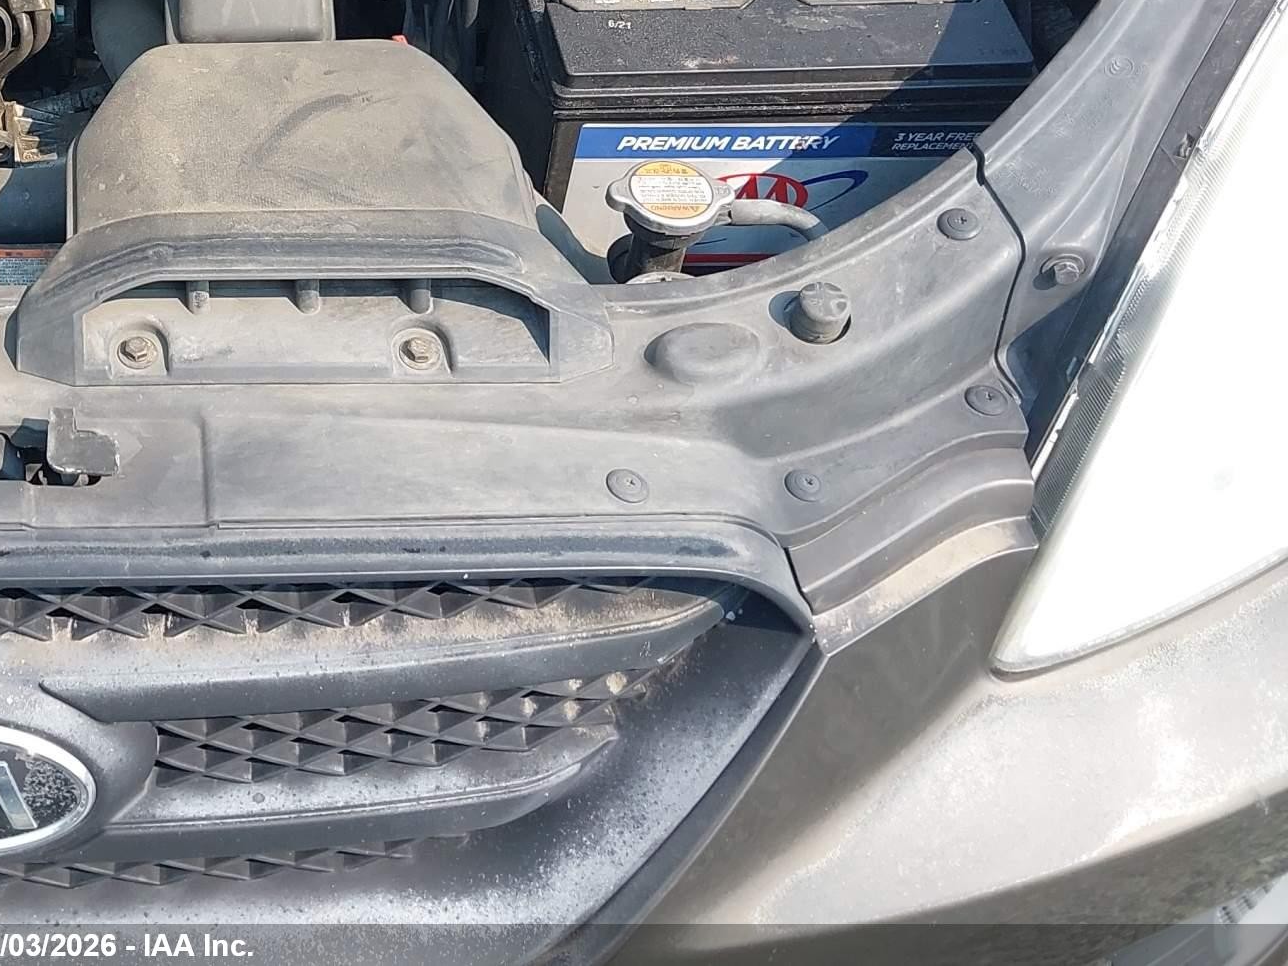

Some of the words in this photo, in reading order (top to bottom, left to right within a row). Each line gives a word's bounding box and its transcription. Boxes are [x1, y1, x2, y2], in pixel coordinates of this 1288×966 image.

[608, 19, 631, 29] 6/21
[894, 132, 907, 141] 3
[907, 132, 944, 141] YEAR
[617, 135, 730, 150] PREMIUM
[731, 135, 840, 150] BATTERY
